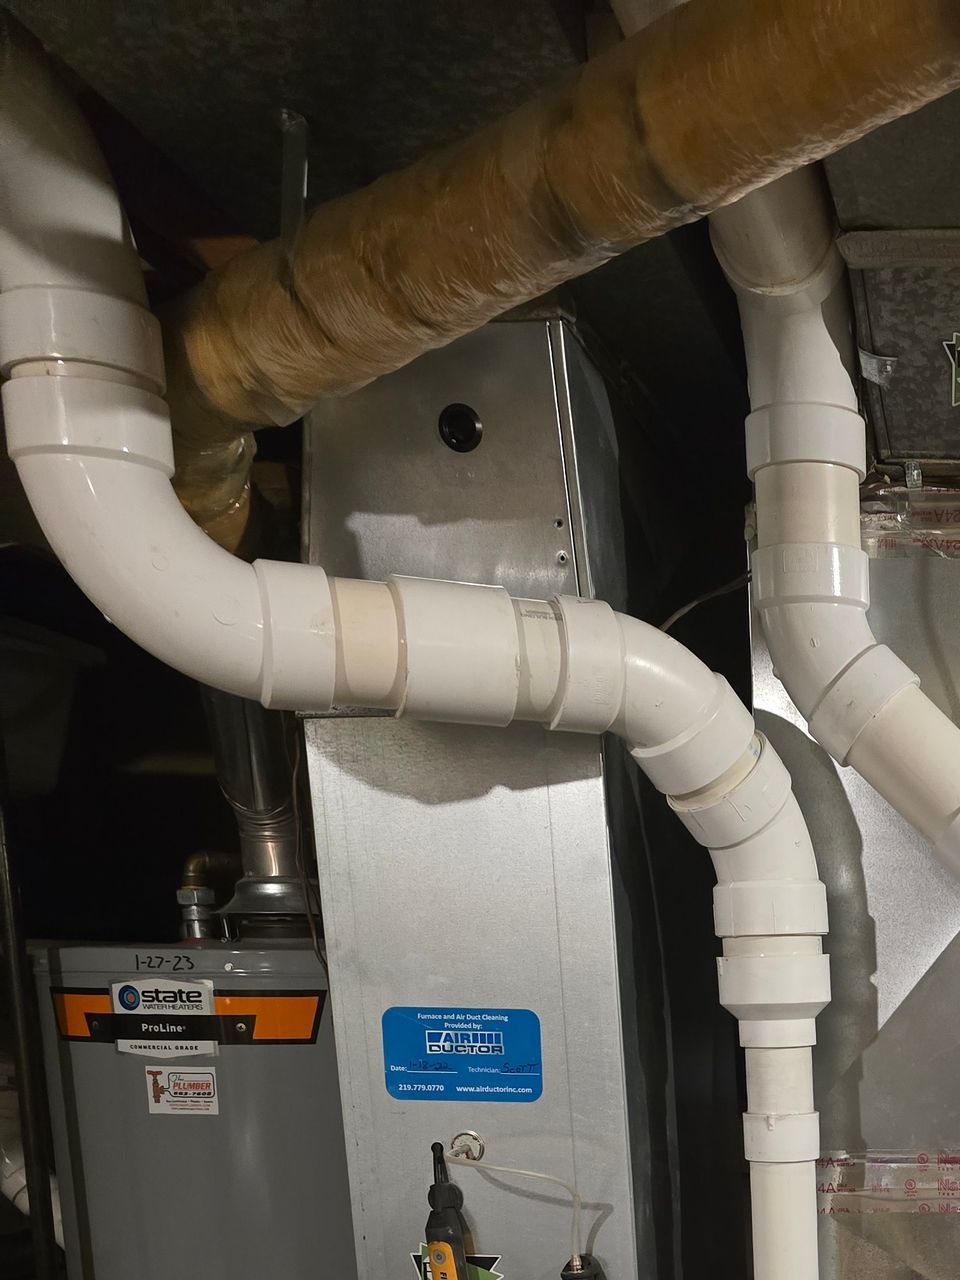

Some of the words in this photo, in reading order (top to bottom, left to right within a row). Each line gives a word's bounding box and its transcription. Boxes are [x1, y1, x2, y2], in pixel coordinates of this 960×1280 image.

[135, 954, 195, 971] 1-27-23
[141, 988, 203, 1004] state
[142, 1003, 167, 1011] WATER
[168, 1003, 204, 1011] HEATERS
[481, 1014, 509, 1022] Cleaning
[141, 1023, 184, 1033] ProLine
[472, 1022, 483, 1030] by:
[443, 1032, 473, 1044] AIR
[428, 1044, 503, 1054] DUCTOR
[468, 1066, 501, 1074] Technician:
[172, 1082, 211, 1090] PLUMBER
[398, 1083, 445, 1092] 219.779.0770
[456, 1085, 533, 1094] www.airductorinc.com
